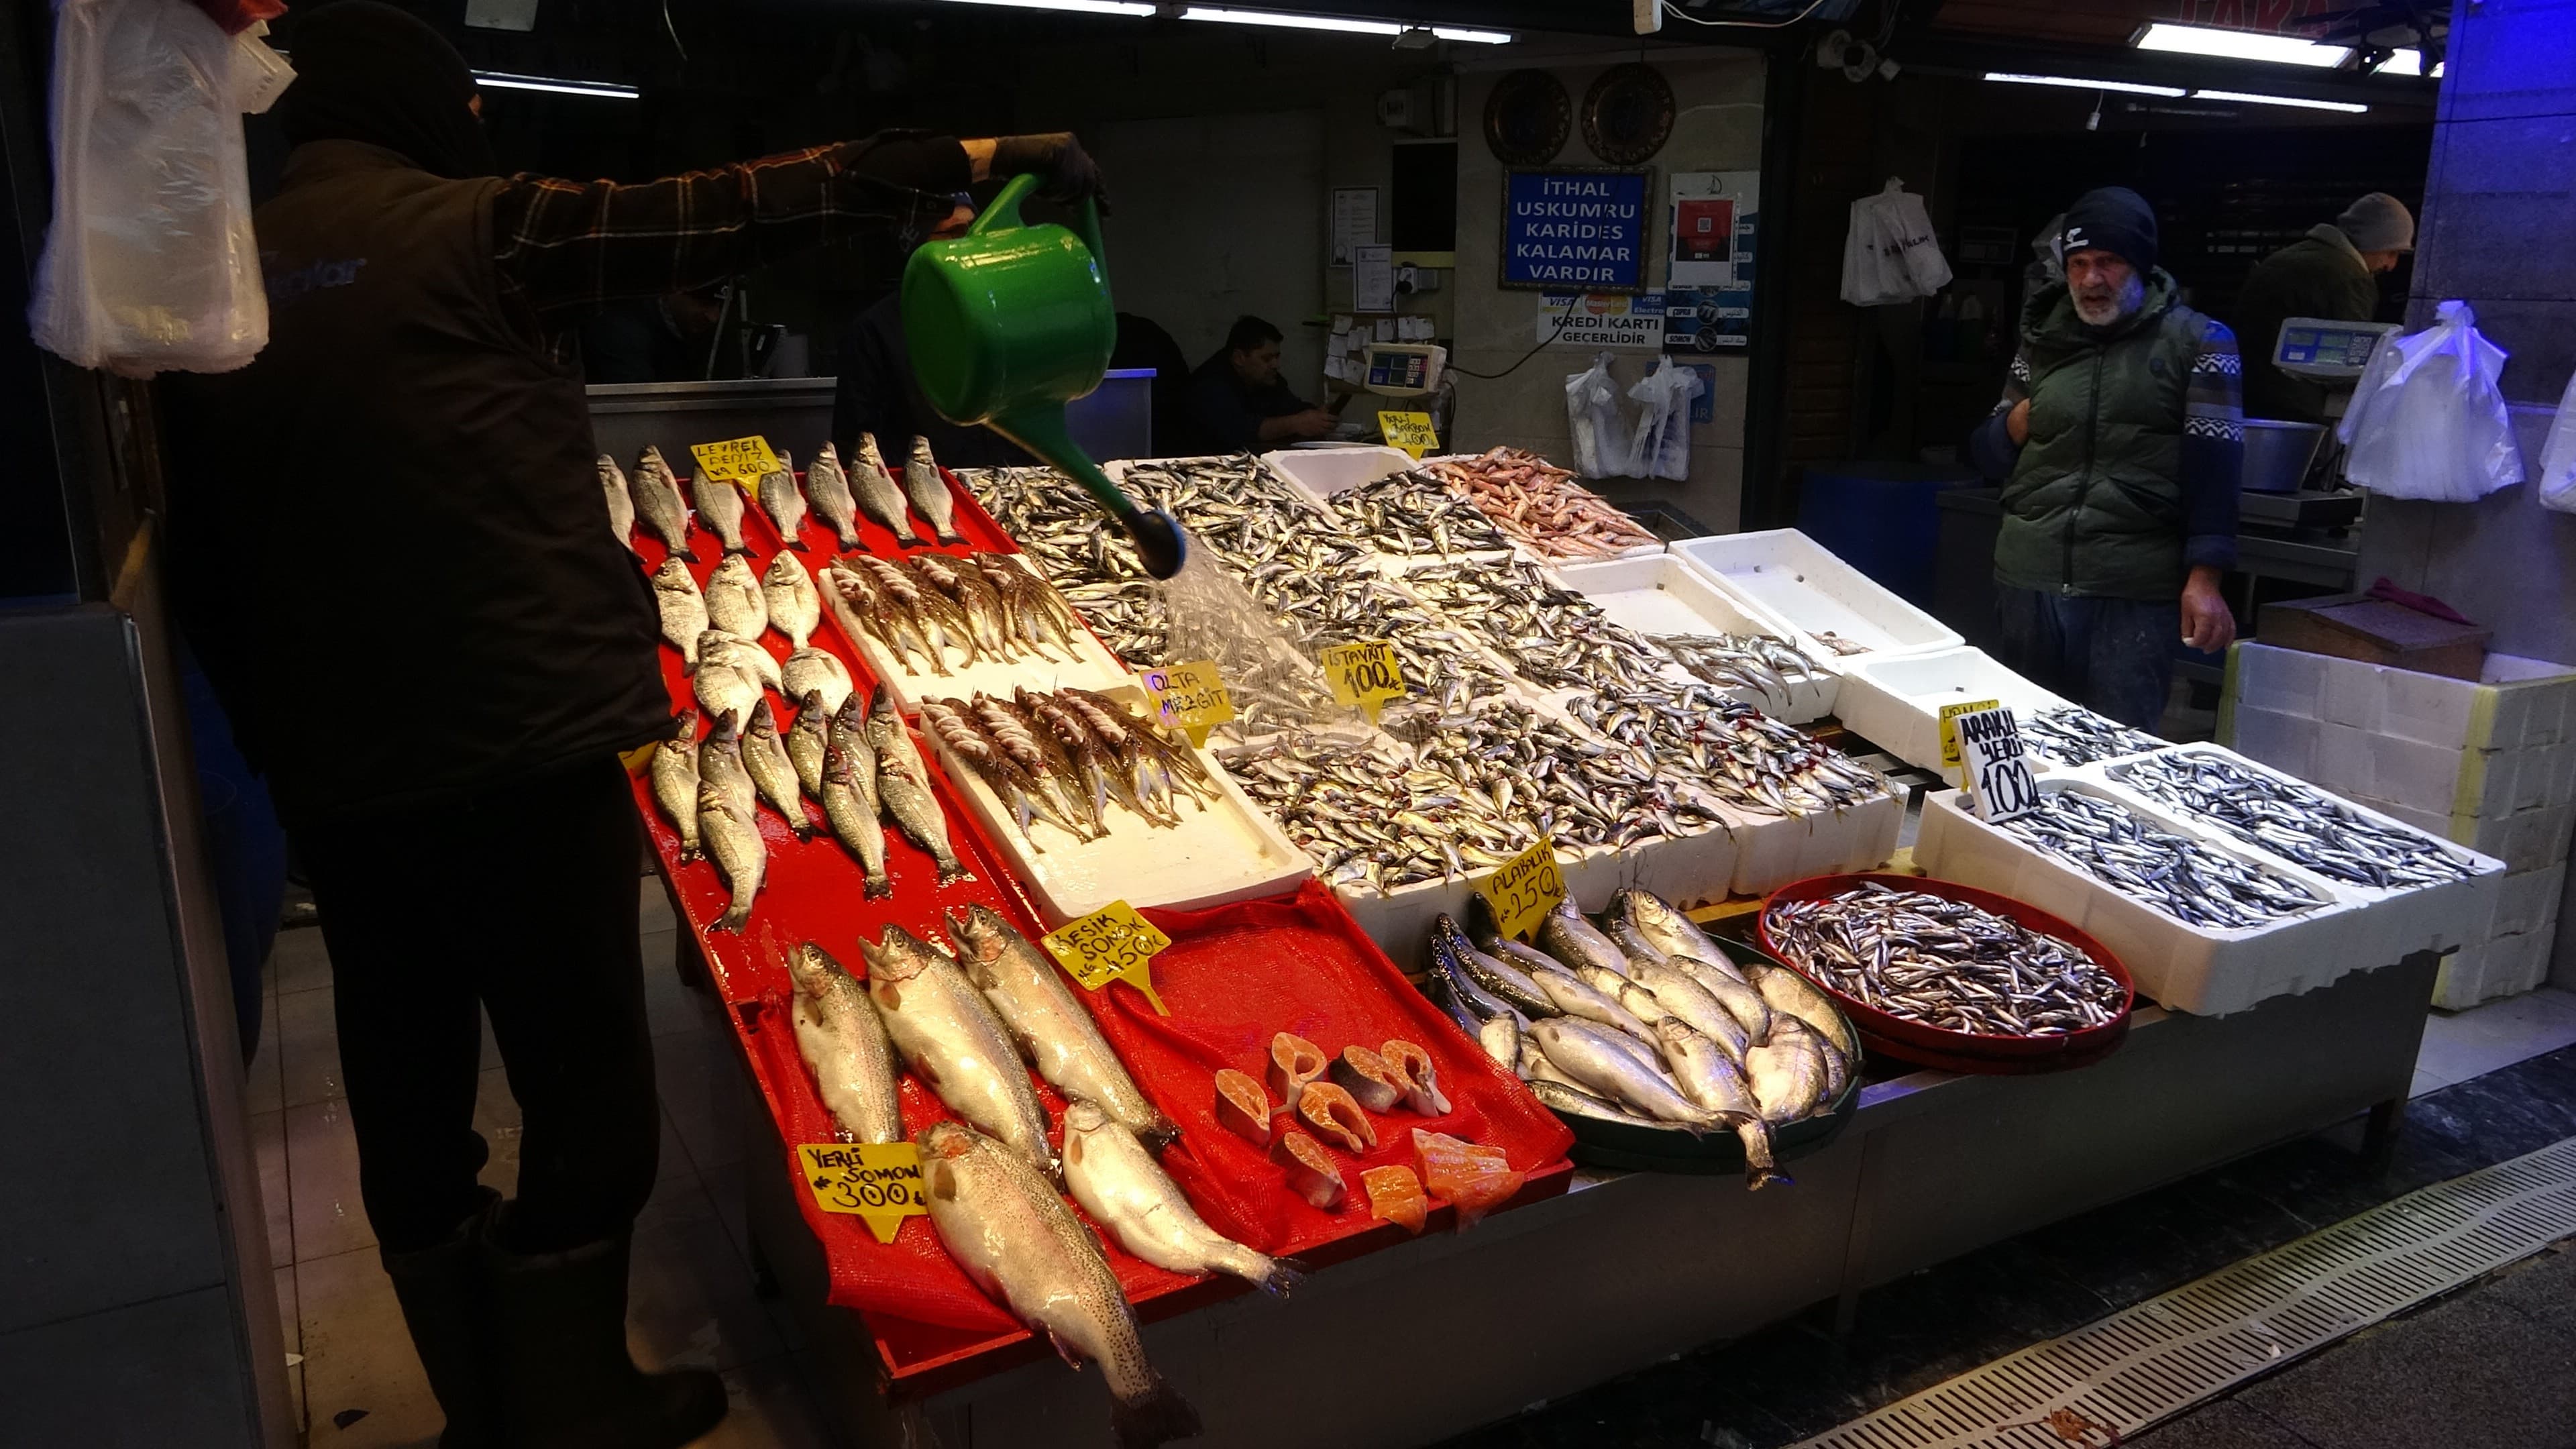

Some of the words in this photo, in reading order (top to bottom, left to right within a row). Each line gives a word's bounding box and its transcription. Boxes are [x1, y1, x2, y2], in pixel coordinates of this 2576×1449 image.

[1544, 178, 1610, 197] İTHAL
[1516, 201, 1635, 219] USKUMRU
[1525, 220, 1623, 240] KARİDES
[1516, 243, 1631, 262] KALAMAR
[1528, 264, 1615, 282] VARDIR
[1552, 315, 1603, 328] KREDİ
[1608, 318, 1659, 330] KARTI
[698, 440, 762, 456] LEVREK
[739, 461, 769, 474] 600
[1151, 672, 1200, 691] OLTA
[1493, 843, 1551, 895] ALABALIK
[807, 1147, 864, 1169] YERLİ
[843, 1165, 921, 1183] SOMON
